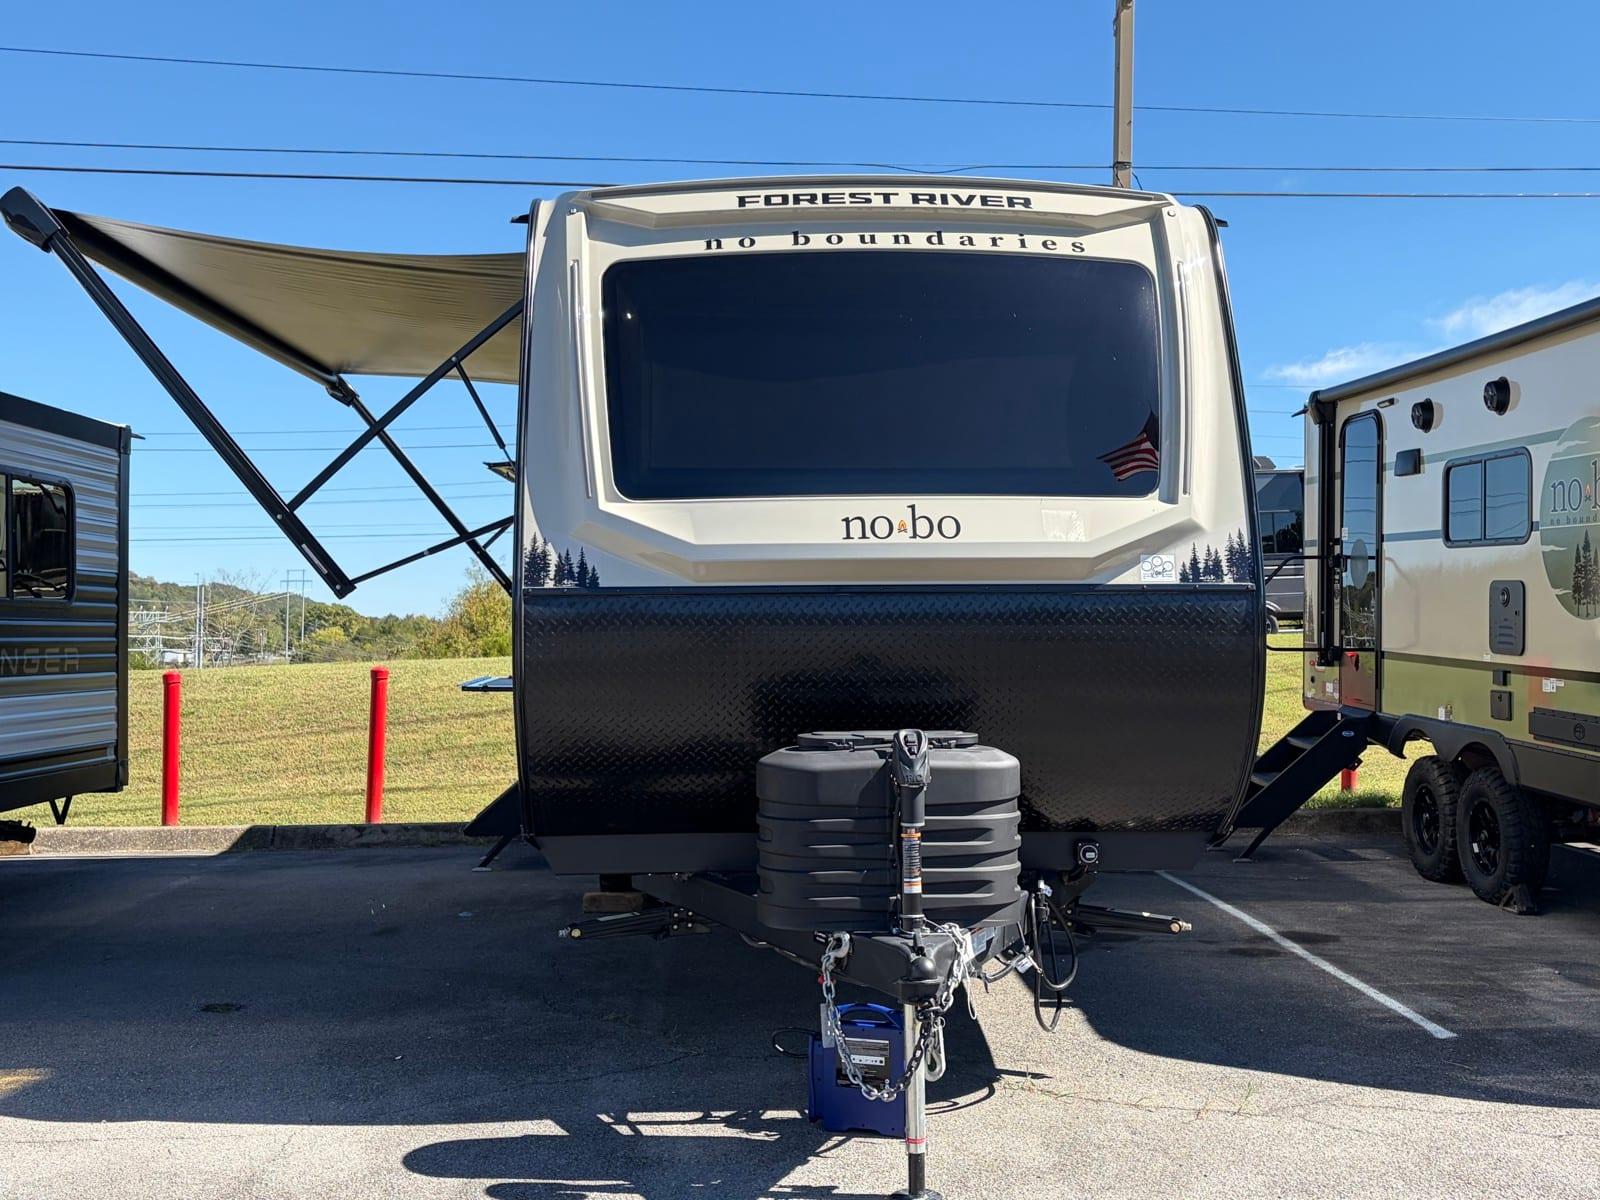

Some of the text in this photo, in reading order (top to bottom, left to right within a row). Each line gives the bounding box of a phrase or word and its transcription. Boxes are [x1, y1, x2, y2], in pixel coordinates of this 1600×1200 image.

[737, 192, 1033, 209] FOREST RIVER
[704, 230, 1086, 254] no boundaries
